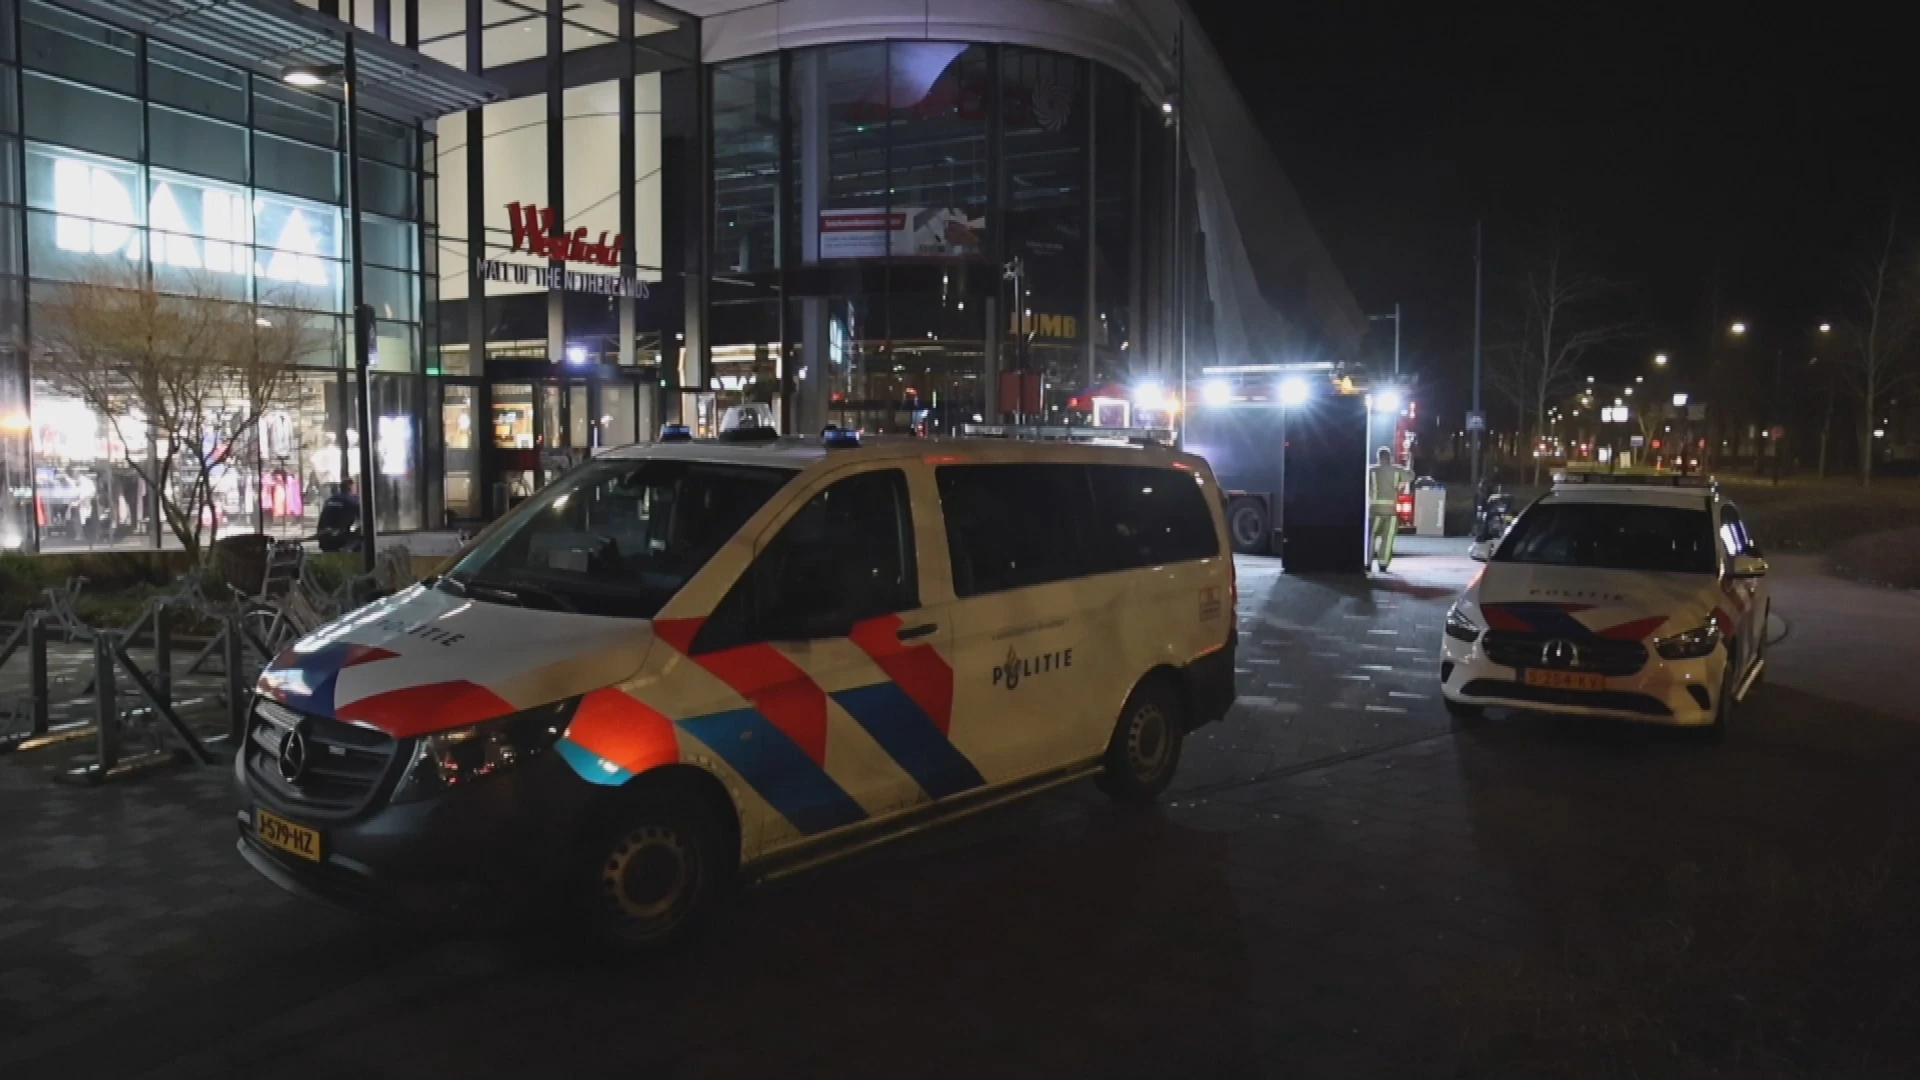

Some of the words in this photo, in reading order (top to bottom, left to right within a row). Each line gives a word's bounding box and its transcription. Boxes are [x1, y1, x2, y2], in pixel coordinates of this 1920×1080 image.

[53, 157, 330, 286] DAKA
[503, 201, 624, 268] Westfield
[476, 255, 509, 284] MALL
[513, 262, 530, 286] OF
[536, 265, 562, 291] THE
[564, 269, 651, 299] NETHERLANDS
[992, 646, 1073, 690] POLITIE
